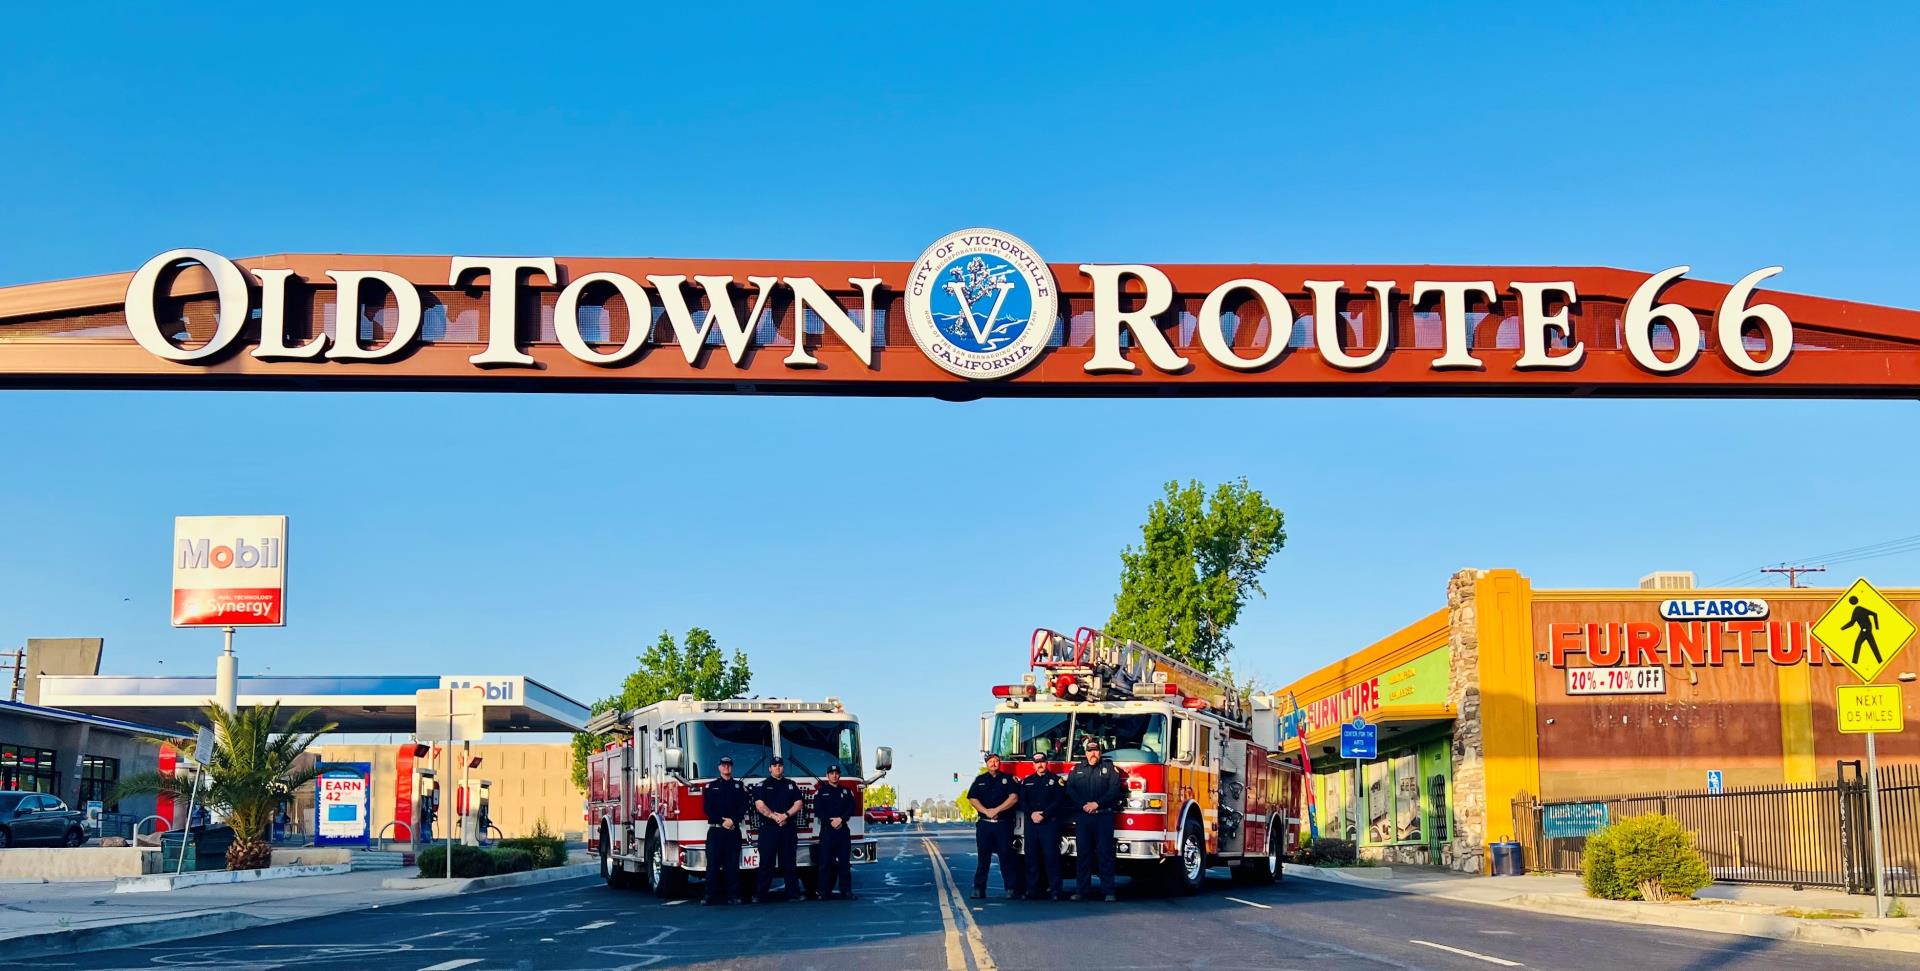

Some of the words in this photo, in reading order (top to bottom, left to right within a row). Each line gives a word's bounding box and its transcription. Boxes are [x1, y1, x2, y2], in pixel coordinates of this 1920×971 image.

[913, 260, 932, 297] CITY
[936, 242, 954, 259] OF
[961, 236, 1049, 298] VICTORVILLE
[125, 248, 422, 363] OLD
[450, 256, 883, 370] TOWN
[1079, 264, 1585, 373] ROUTE
[1624, 265, 1794, 373] 66
[948, 282, 1015, 344] V
[932, 343, 1032, 371] CALIFORNIA
[178, 538, 279, 569] Mobil
[208, 600, 273, 616] Synergy
[1667, 600, 1749, 617] ALFARO
[1549, 621, 1844, 667] FURNITUR
[1572, 672, 1596, 690] 20%
[1609, 671, 1634, 690] 70%
[1637, 670, 1660, 689] OFF
[1306, 678, 1379, 733] FURNITURE
[1856, 695, 1884, 706] NEXT
[1865, 710, 1893, 721] MILES
[325, 781, 361, 791] EARN
[325, 792, 341, 801] 42
